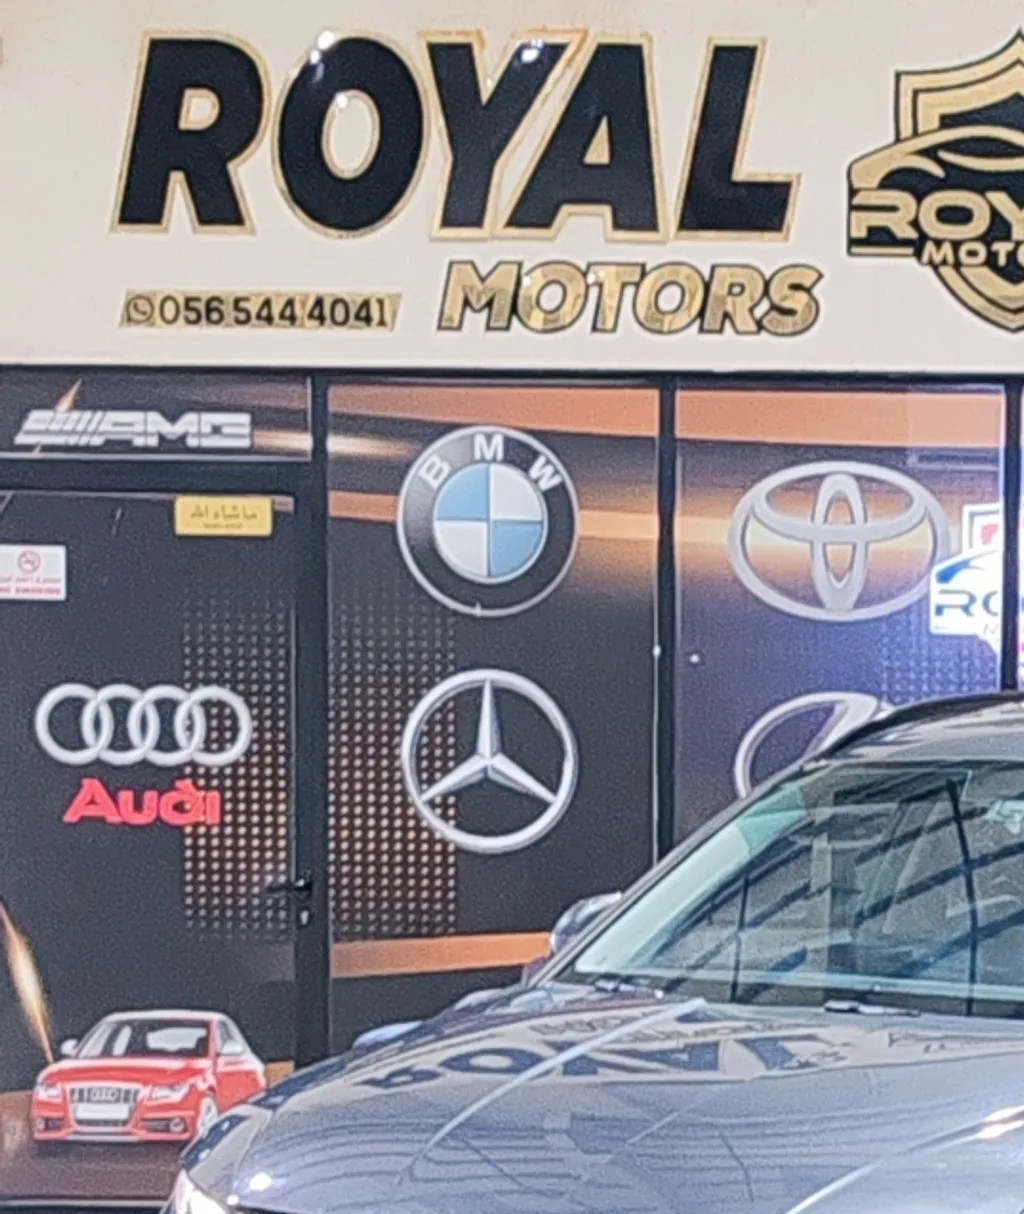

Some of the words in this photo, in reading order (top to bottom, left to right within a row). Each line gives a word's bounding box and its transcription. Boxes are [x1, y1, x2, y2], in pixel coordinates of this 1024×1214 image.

[110, 29, 801, 243] ROYAL
[159, 295, 225, 326] 056
[232, 296, 297, 327] 544
[306, 296, 387, 328] 4041
[437, 261, 823, 337] MOTORS
[96, 410, 251, 448] AMG
[418, 434, 563, 491] BMW
[62, 777, 222, 826] Audi
